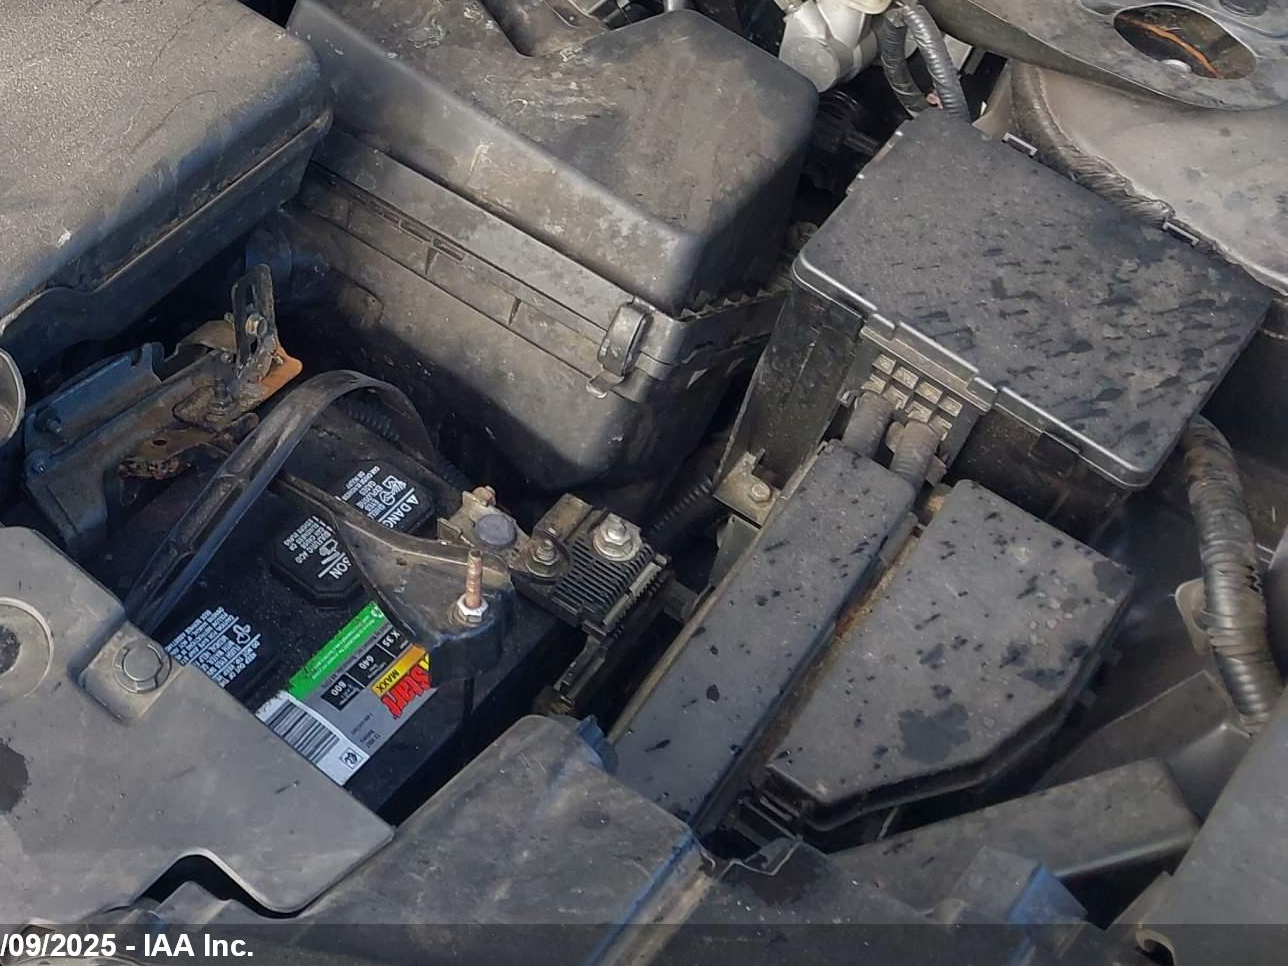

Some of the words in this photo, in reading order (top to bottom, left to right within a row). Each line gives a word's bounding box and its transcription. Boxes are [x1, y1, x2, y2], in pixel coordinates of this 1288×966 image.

[382, 635, 394, 647] 35
[358, 655, 374, 669] 640
[376, 669, 399, 692] MAXX
[381, 652, 432, 719] Start
